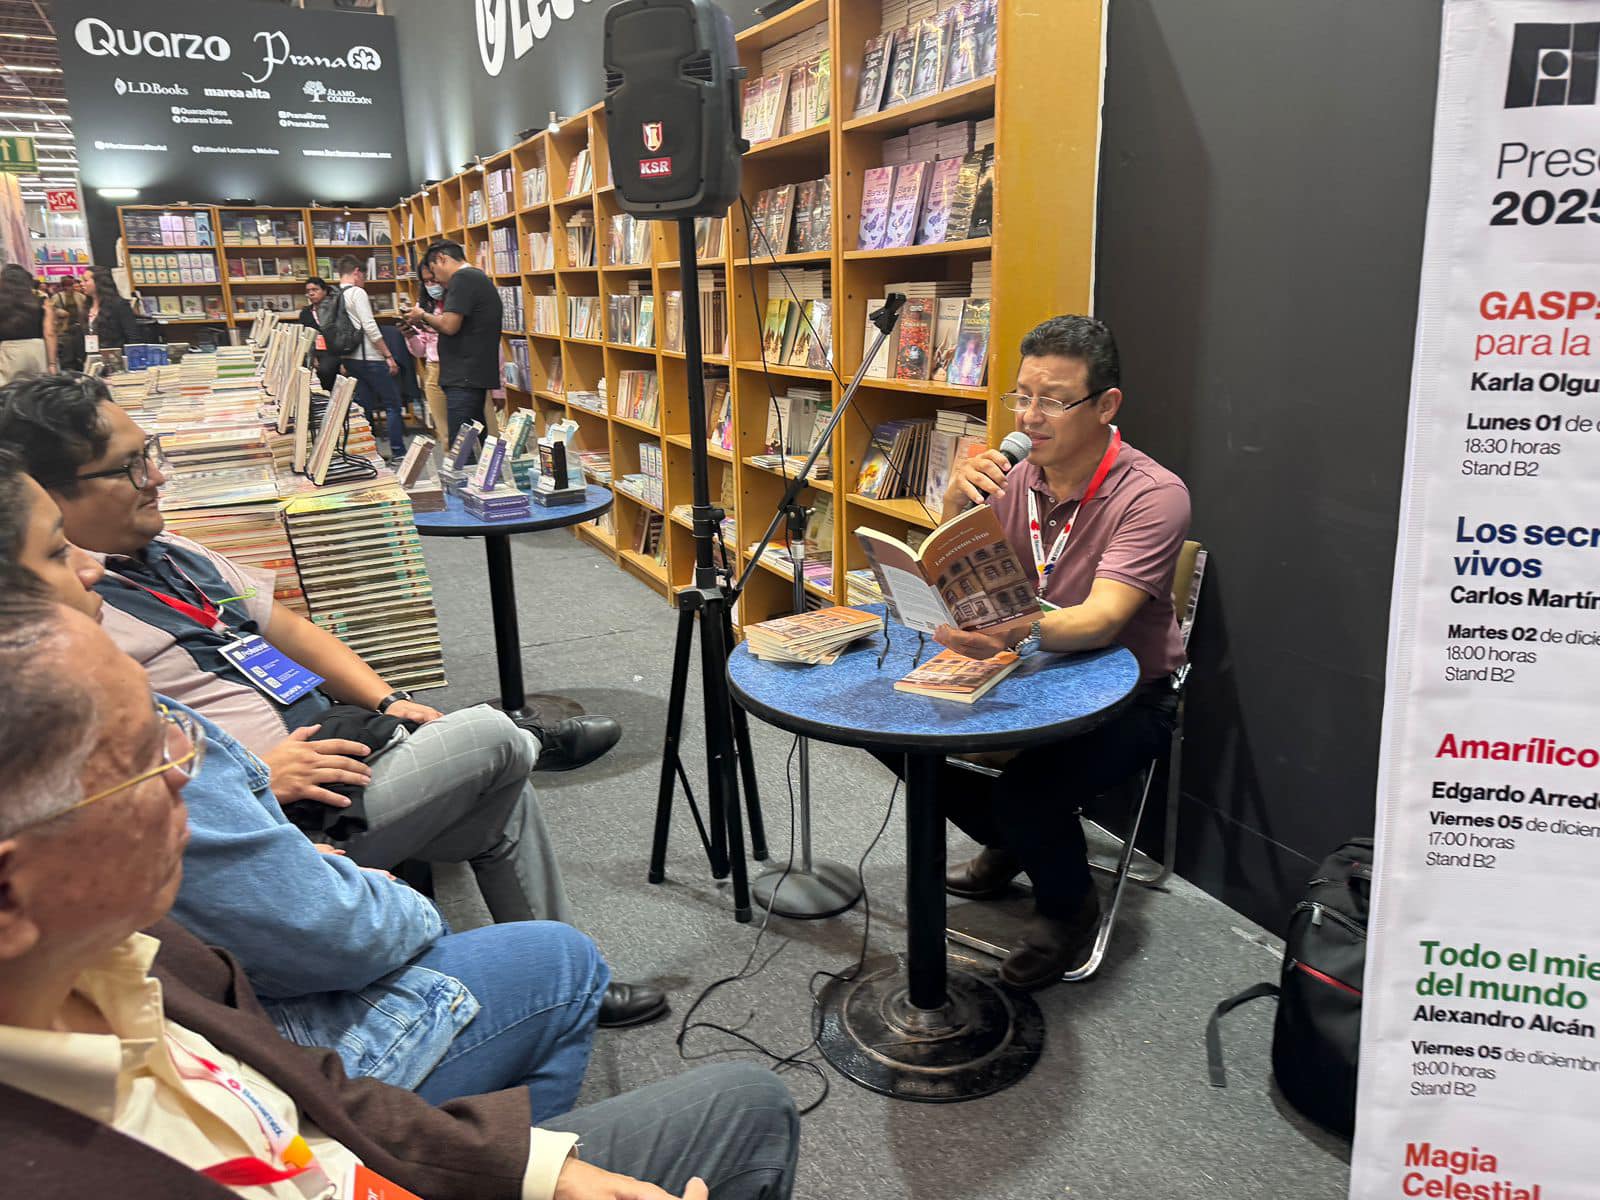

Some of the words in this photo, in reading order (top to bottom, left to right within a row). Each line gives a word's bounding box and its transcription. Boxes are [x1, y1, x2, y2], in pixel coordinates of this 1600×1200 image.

[75, 18, 231, 62] Quarzo
[242, 31, 346, 84] Prana
[204, 87, 244, 99] marea
[245, 88, 271, 100] alta
[640, 160, 669, 174] KSR
[1497, 142, 1600, 179] Pres
[1474, 333, 1553, 361] para
[1561, 327, 1591, 356] la
[1470, 372, 1534, 392] Karla
[1466, 413, 1532, 430] Lunes
[1535, 414, 1562, 431] 01
[1565, 415, 1593, 433] de
[1464, 438, 1508, 454] 18:30
[1511, 438, 1561, 455] horas
[1461, 459, 1512, 476] Stand
[1514, 460, 1540, 476] B2
[1456, 516, 1518, 544] Los
[1453, 549, 1543, 579] vivos
[1450, 585, 1524, 605] Carlos
[1447, 624, 1508, 640] Martes
[1511, 627, 1538, 641] 02
[1540, 628, 1563, 644] de
[1446, 645, 1486, 660] 18:00
[1488, 646, 1538, 664] horas
[1445, 666, 1489, 681] Stand
[1491, 667, 1516, 683] B2
[1435, 733, 1600, 768] Amarílico
[1431, 781, 1526, 803] Edgardo
[1528, 787, 1600, 810] Arred
[1429, 811, 1495, 828] Viernes
[1497, 815, 1523, 830] 05
[1525, 817, 1548, 832] de
[1428, 831, 1467, 846] 17:00
[1470, 833, 1516, 850] horas
[1425, 851, 1470, 867] Stand
[1473, 853, 1496, 869] B2
[1419, 940, 1502, 970] Todo
[1507, 948, 1538, 973] el
[1415, 971, 1464, 997] del
[1469, 979, 1588, 1010] mundo
[1413, 1005, 1526, 1029] Alexandro
[1528, 1014, 1596, 1038] Alcán
[1411, 1040, 1475, 1058] Viernes
[1477, 1044, 1503, 1060] 05
[1504, 1048, 1526, 1063] de
[1412, 1060, 1449, 1076] 19:00
[1451, 1062, 1497, 1080] horas
[1410, 1081, 1451, 1096] Stand
[1453, 1082, 1477, 1098] B2
[1404, 1142, 1498, 1175] Magia
[1402, 1171, 1542, 1200] Celestial
